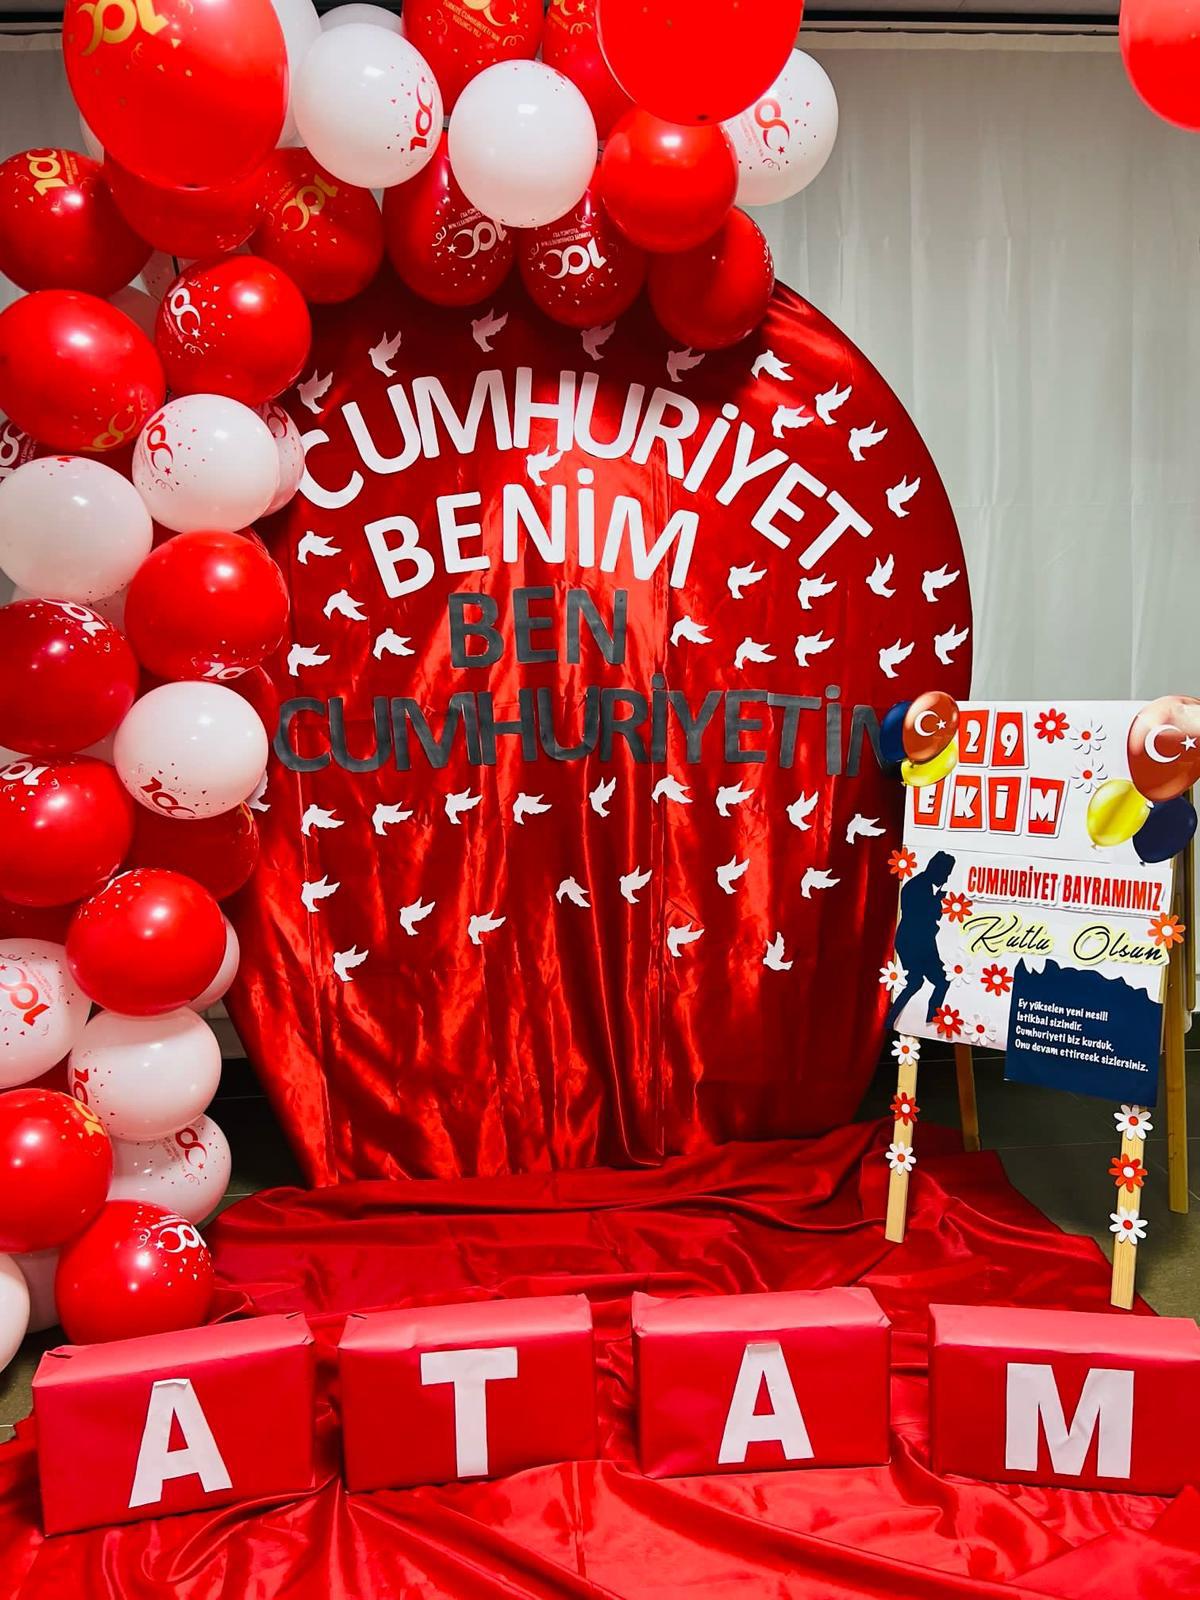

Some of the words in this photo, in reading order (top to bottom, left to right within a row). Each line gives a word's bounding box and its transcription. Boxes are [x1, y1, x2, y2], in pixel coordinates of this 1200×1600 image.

[298, 366, 873, 570] CUMHURİYET
[363, 468, 700, 599] BENİM
[447, 586, 628, 669] BEN
[965, 719, 1019, 757] 29
[918, 783, 1058, 822] EKİM
[968, 866, 1058, 901] CUMHURİYET
[1063, 874, 1163, 911] BAYRAMIMIZ
[963, 915, 1050, 953] Kutlu
[1074, 925, 1163, 960] Olsun
[1018, 998, 1028, 1009] Ey
[1066, 1007, 1084, 1018] yeni
[1015, 1039, 1031, 1050] Onu
[1032, 1042, 1058, 1056] devam
[1060, 1048, 1100, 1063] ettirecek
[1101, 1055, 1149, 1072] sizlersiniz.
[1016, 1025, 1066, 1042] Cumhuriyeti
[1067, 1035, 1080, 1045] biz
[1082, 1036, 1114, 1052] kurduk,
